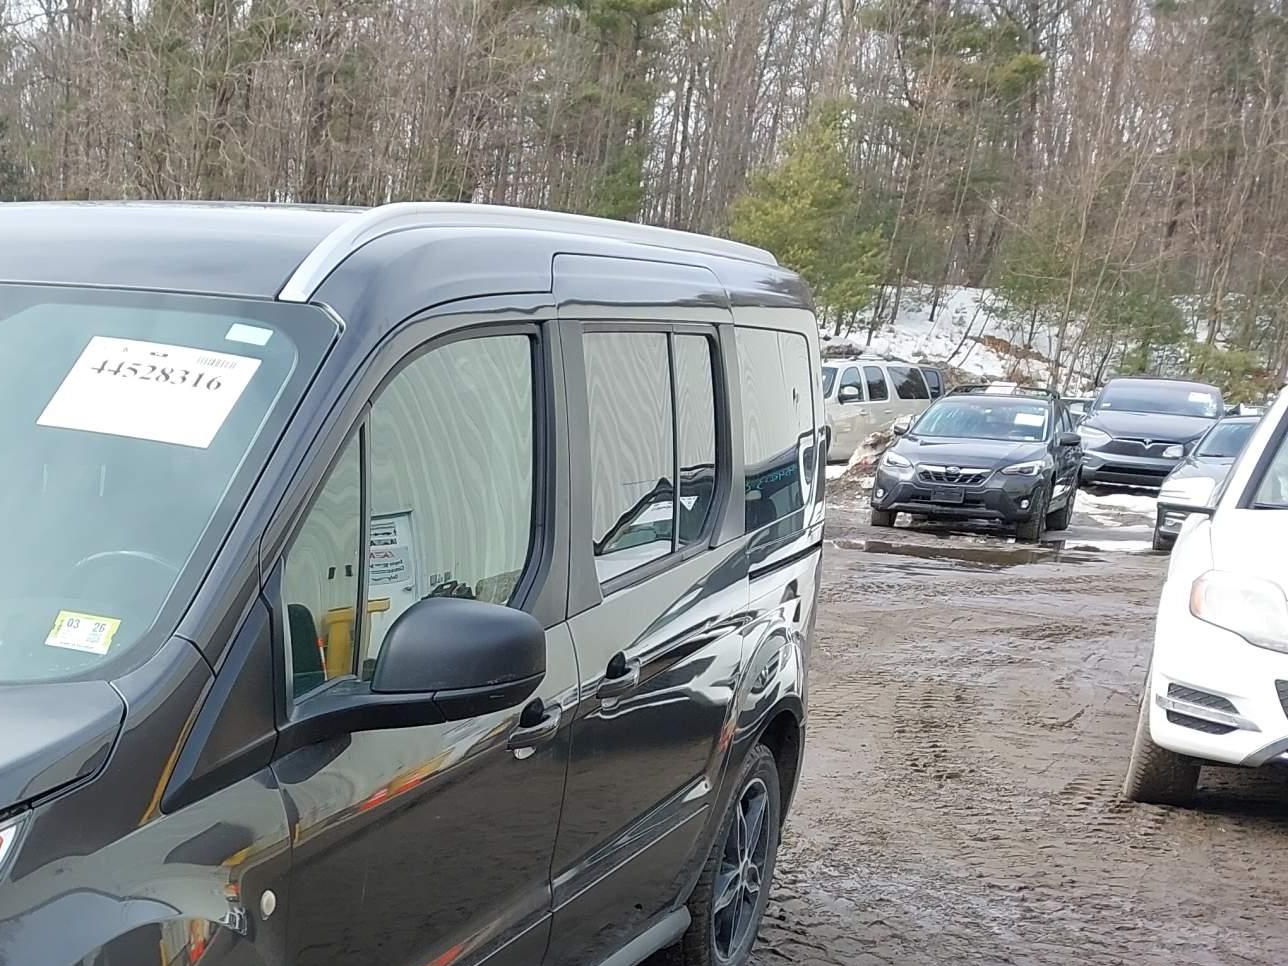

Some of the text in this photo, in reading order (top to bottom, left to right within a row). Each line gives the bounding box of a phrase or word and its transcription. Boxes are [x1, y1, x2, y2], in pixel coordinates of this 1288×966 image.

[90, 359, 223, 391] 44528316
[66, 617, 81, 629] 03
[92, 622, 107, 633] 26
